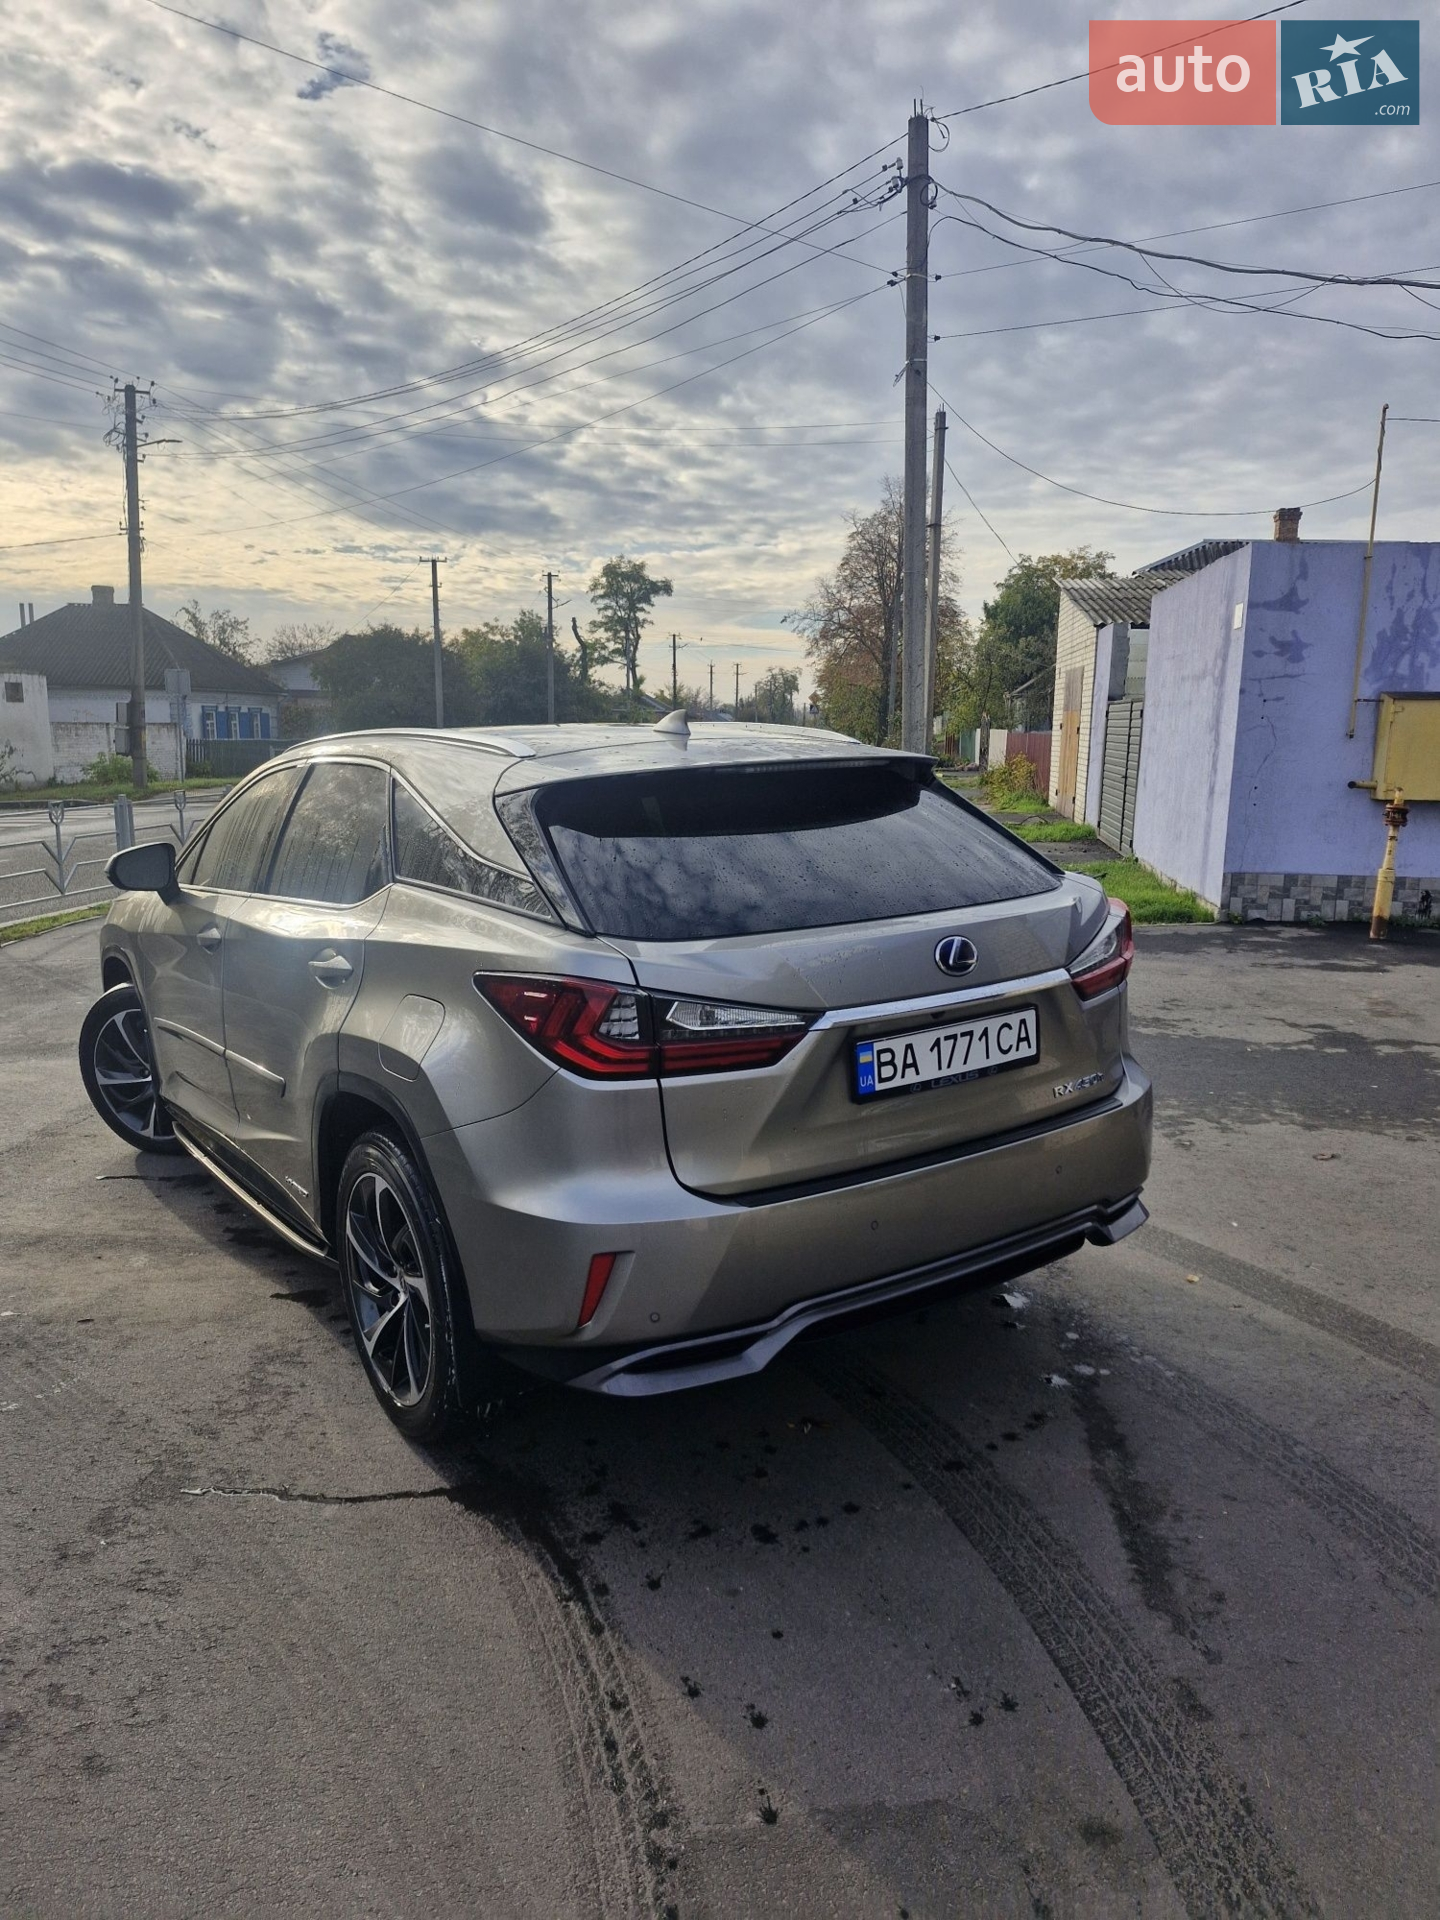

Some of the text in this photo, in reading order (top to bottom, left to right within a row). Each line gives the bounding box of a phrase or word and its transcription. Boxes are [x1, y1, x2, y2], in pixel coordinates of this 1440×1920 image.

[876, 1043, 920, 1084] BA
[860, 1075, 874, 1087] UA
[931, 1070, 979, 1088] LEXUS
[1053, 1082, 1073, 1098] RX
